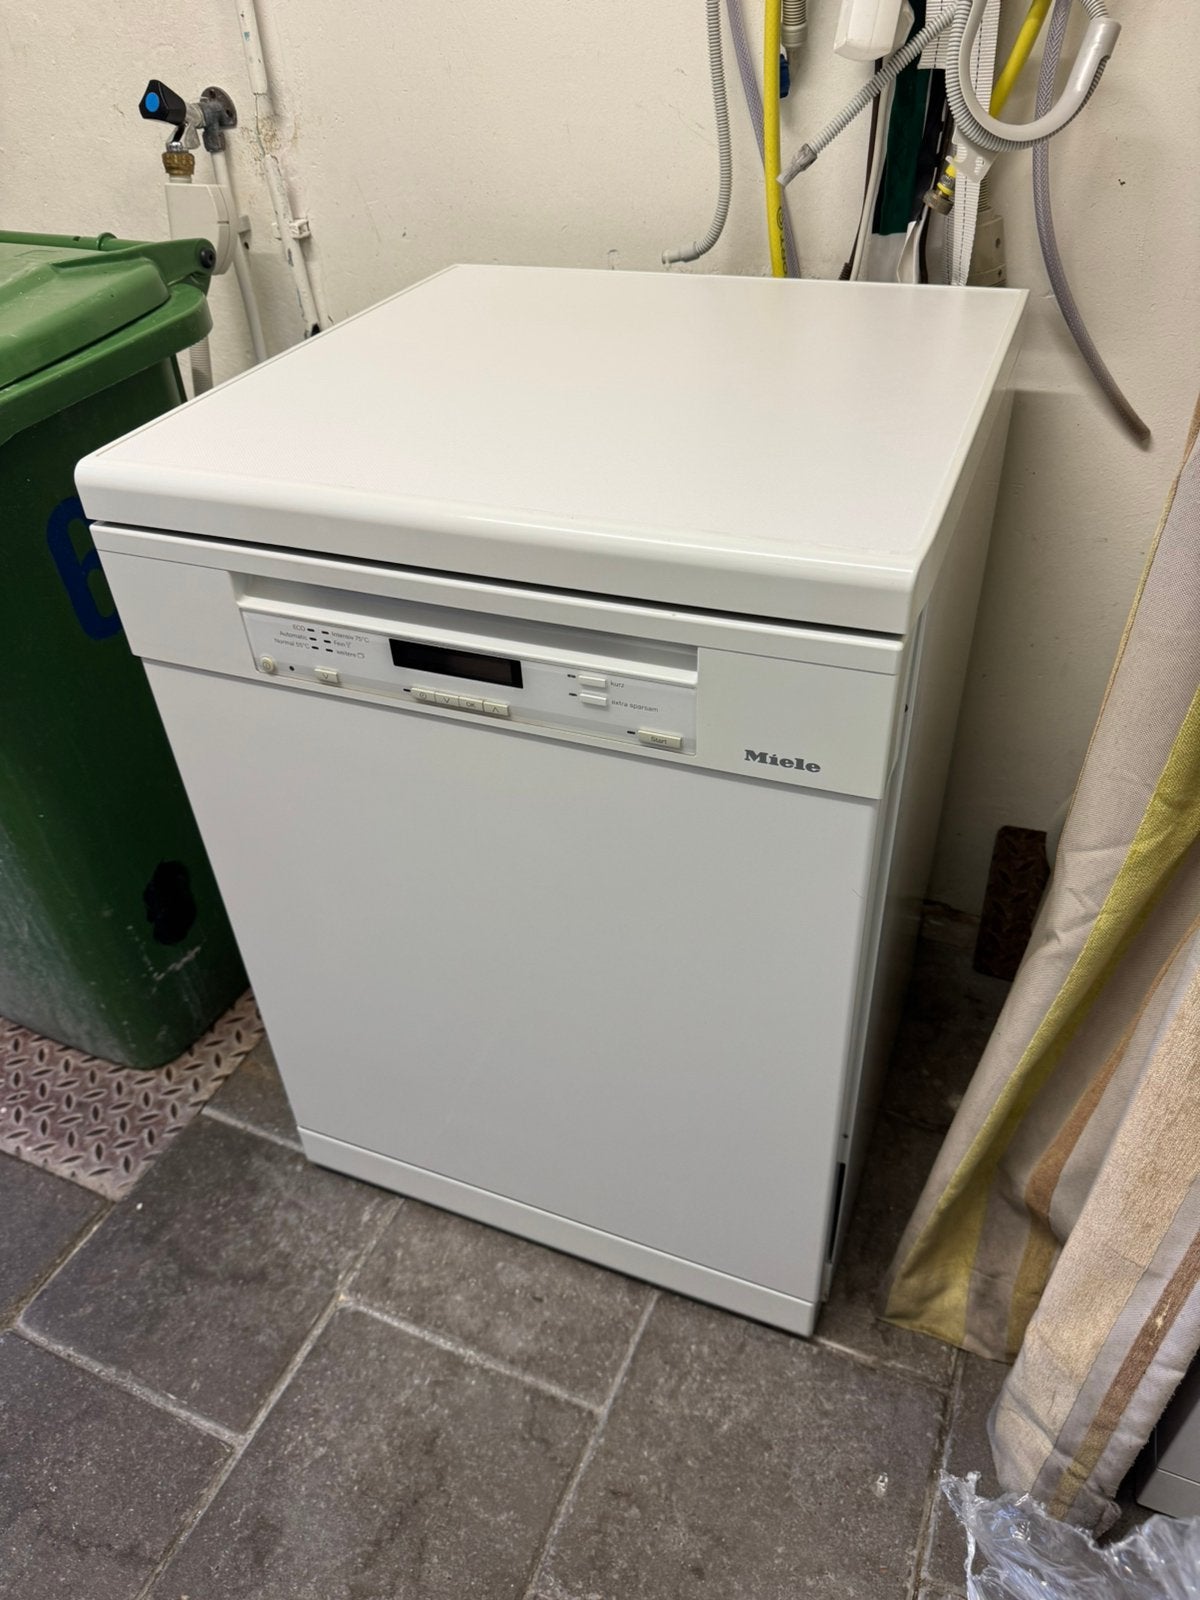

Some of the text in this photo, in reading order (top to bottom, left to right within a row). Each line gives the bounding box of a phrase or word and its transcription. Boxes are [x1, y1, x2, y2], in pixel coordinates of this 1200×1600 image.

[292, 624, 306, 632] ECO
[279, 630, 308, 641] Automatic
[274, 638, 294, 646] Normal
[610, 681, 624, 689] kurz
[611, 699, 659, 713] extra sparsam
[650, 736, 667, 745] Start
[744, 749, 821, 773] Miele
